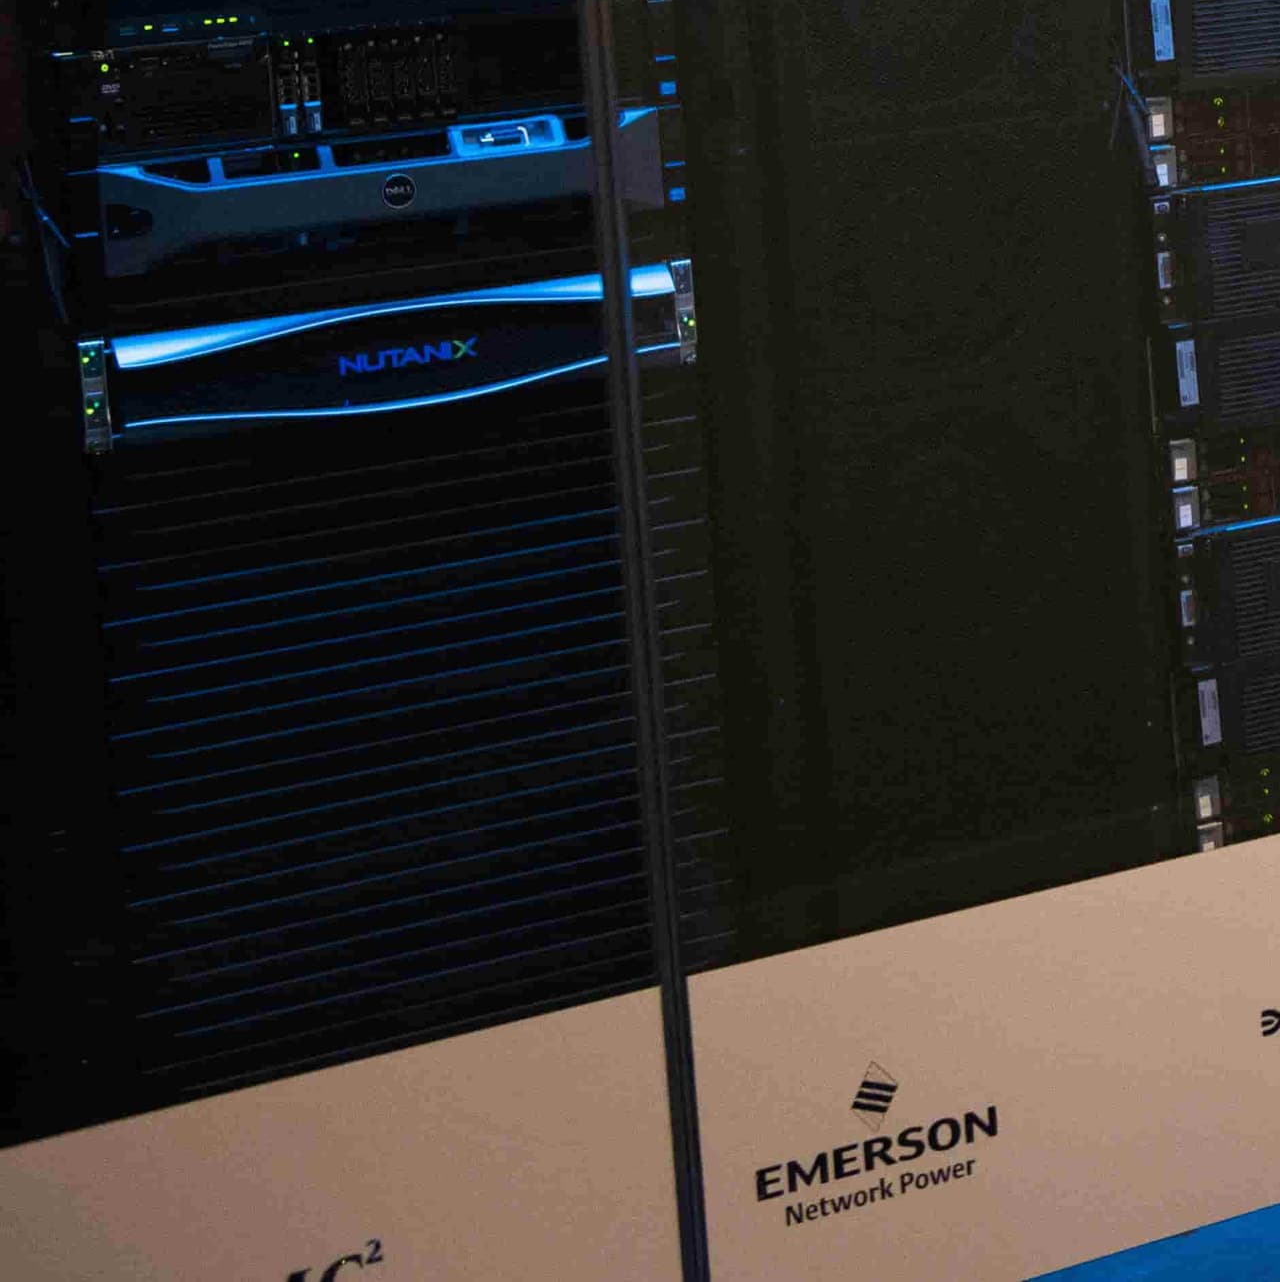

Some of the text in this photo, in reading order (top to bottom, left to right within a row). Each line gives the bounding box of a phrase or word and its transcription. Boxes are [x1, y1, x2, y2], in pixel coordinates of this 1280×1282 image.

[337, 334, 479, 377] NUTANIX
[755, 1105, 998, 1202] EMERSON
[785, 1158, 977, 1227] Network Power
